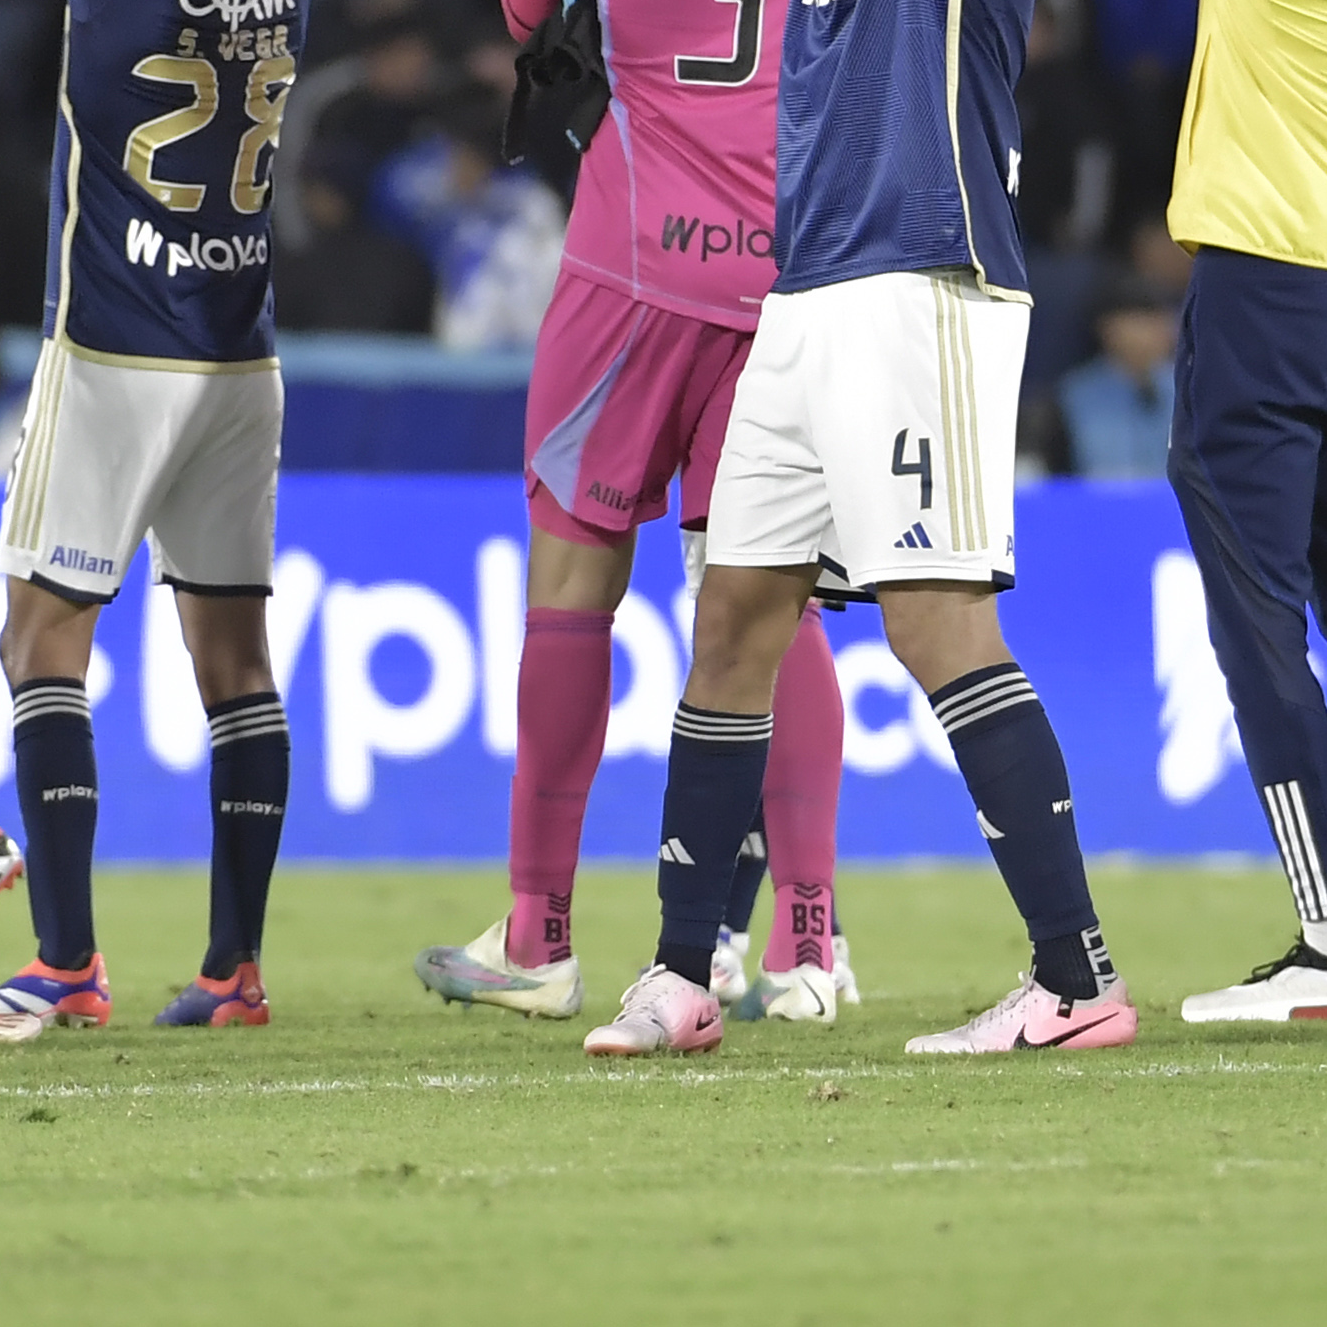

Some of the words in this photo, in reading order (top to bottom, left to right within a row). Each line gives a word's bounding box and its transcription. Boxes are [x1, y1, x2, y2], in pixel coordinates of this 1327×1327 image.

[124, 53, 296, 214] 28
[890, 427, 933, 510] 4
[791, 903, 826, 936] BS
